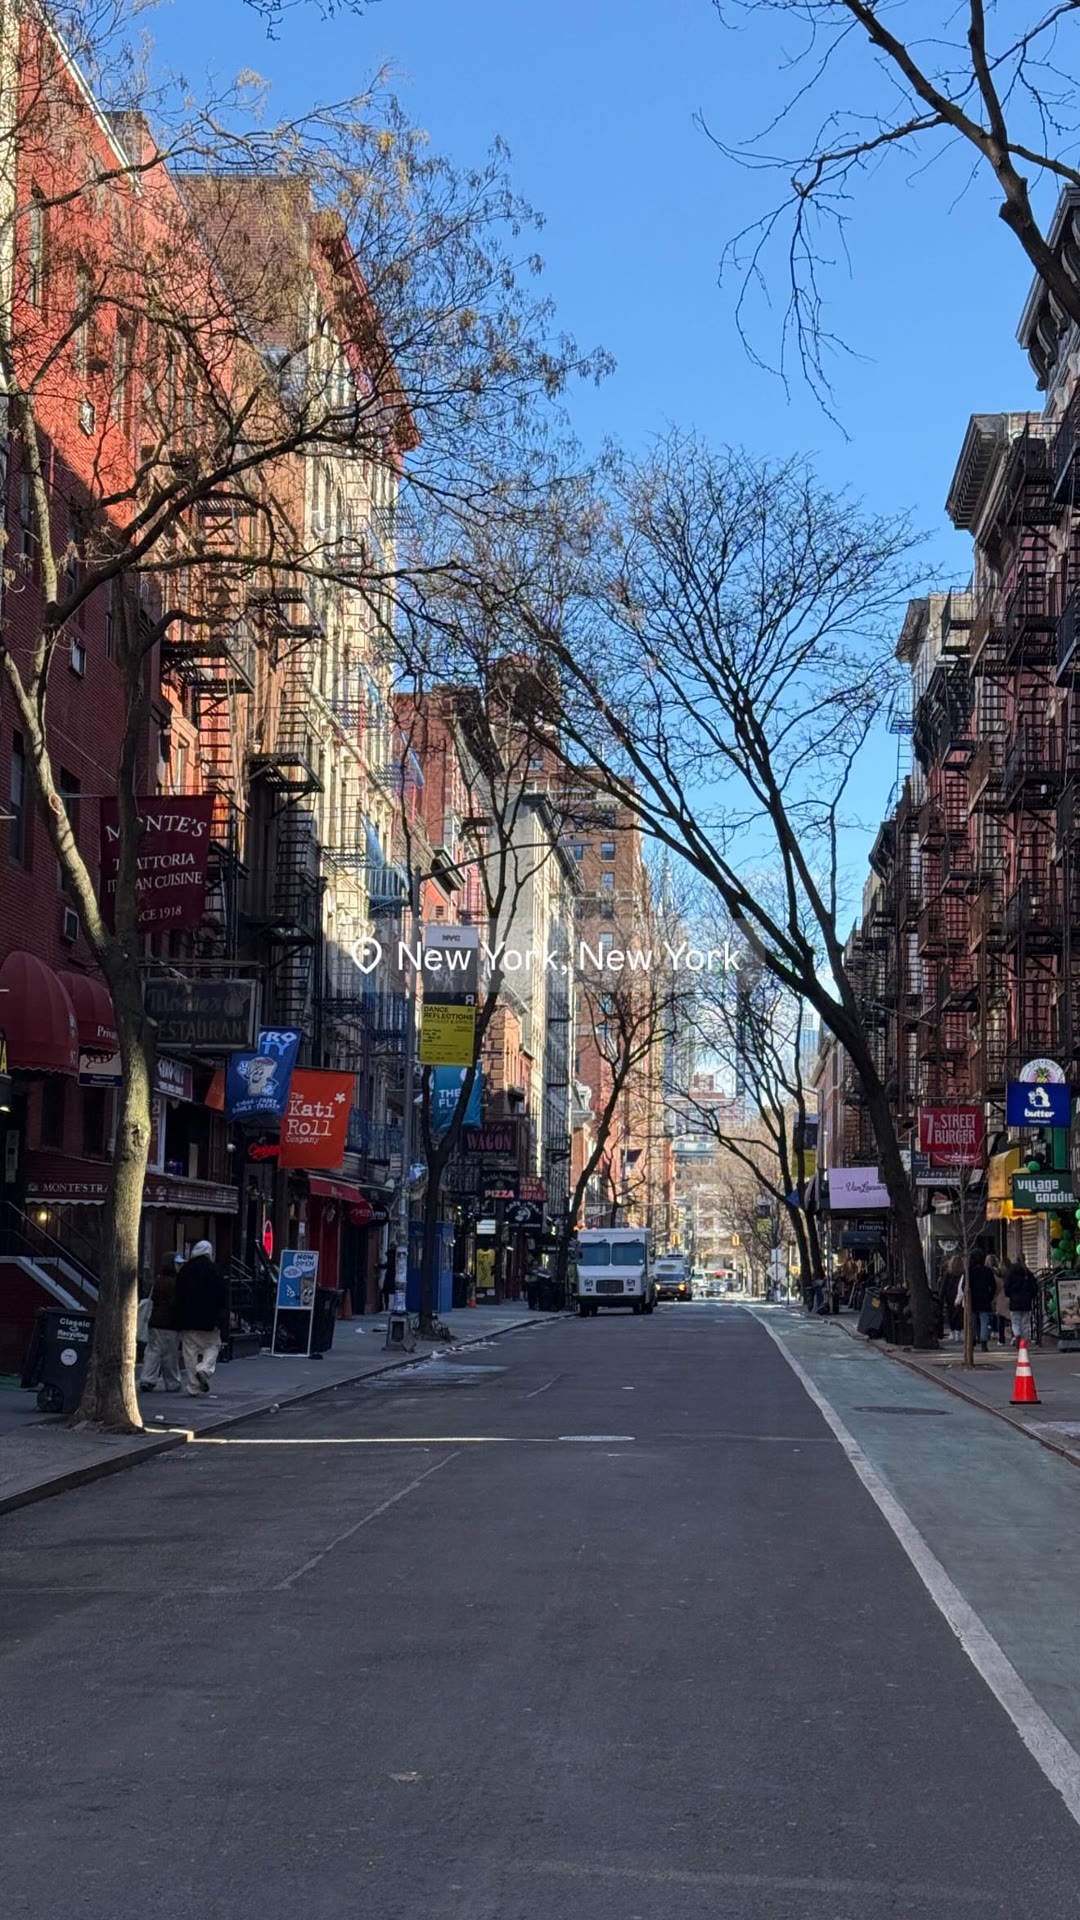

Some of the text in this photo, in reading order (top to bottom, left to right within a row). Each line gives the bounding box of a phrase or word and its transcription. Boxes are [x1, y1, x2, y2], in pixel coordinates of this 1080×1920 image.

[105, 815, 207, 842] MNTE'S
[112, 852, 195, 871] TTTORIA
[154, 871, 203, 889] CUISINE
[159, 905, 182, 920] 1918
[424, 1012, 473, 1020] REFLECTIONS
[439, 1089, 461, 1098] THE
[288, 1100, 335, 1118] Kati
[1024, 1108, 1055, 1119] butter
[286, 1119, 332, 1136] Roll
[940, 1114, 976, 1129] STREET
[467, 1134, 512, 1150] WAGON
[935, 1130, 976, 1145] BURGER
[484, 1189, 515, 1198] PIZZA
